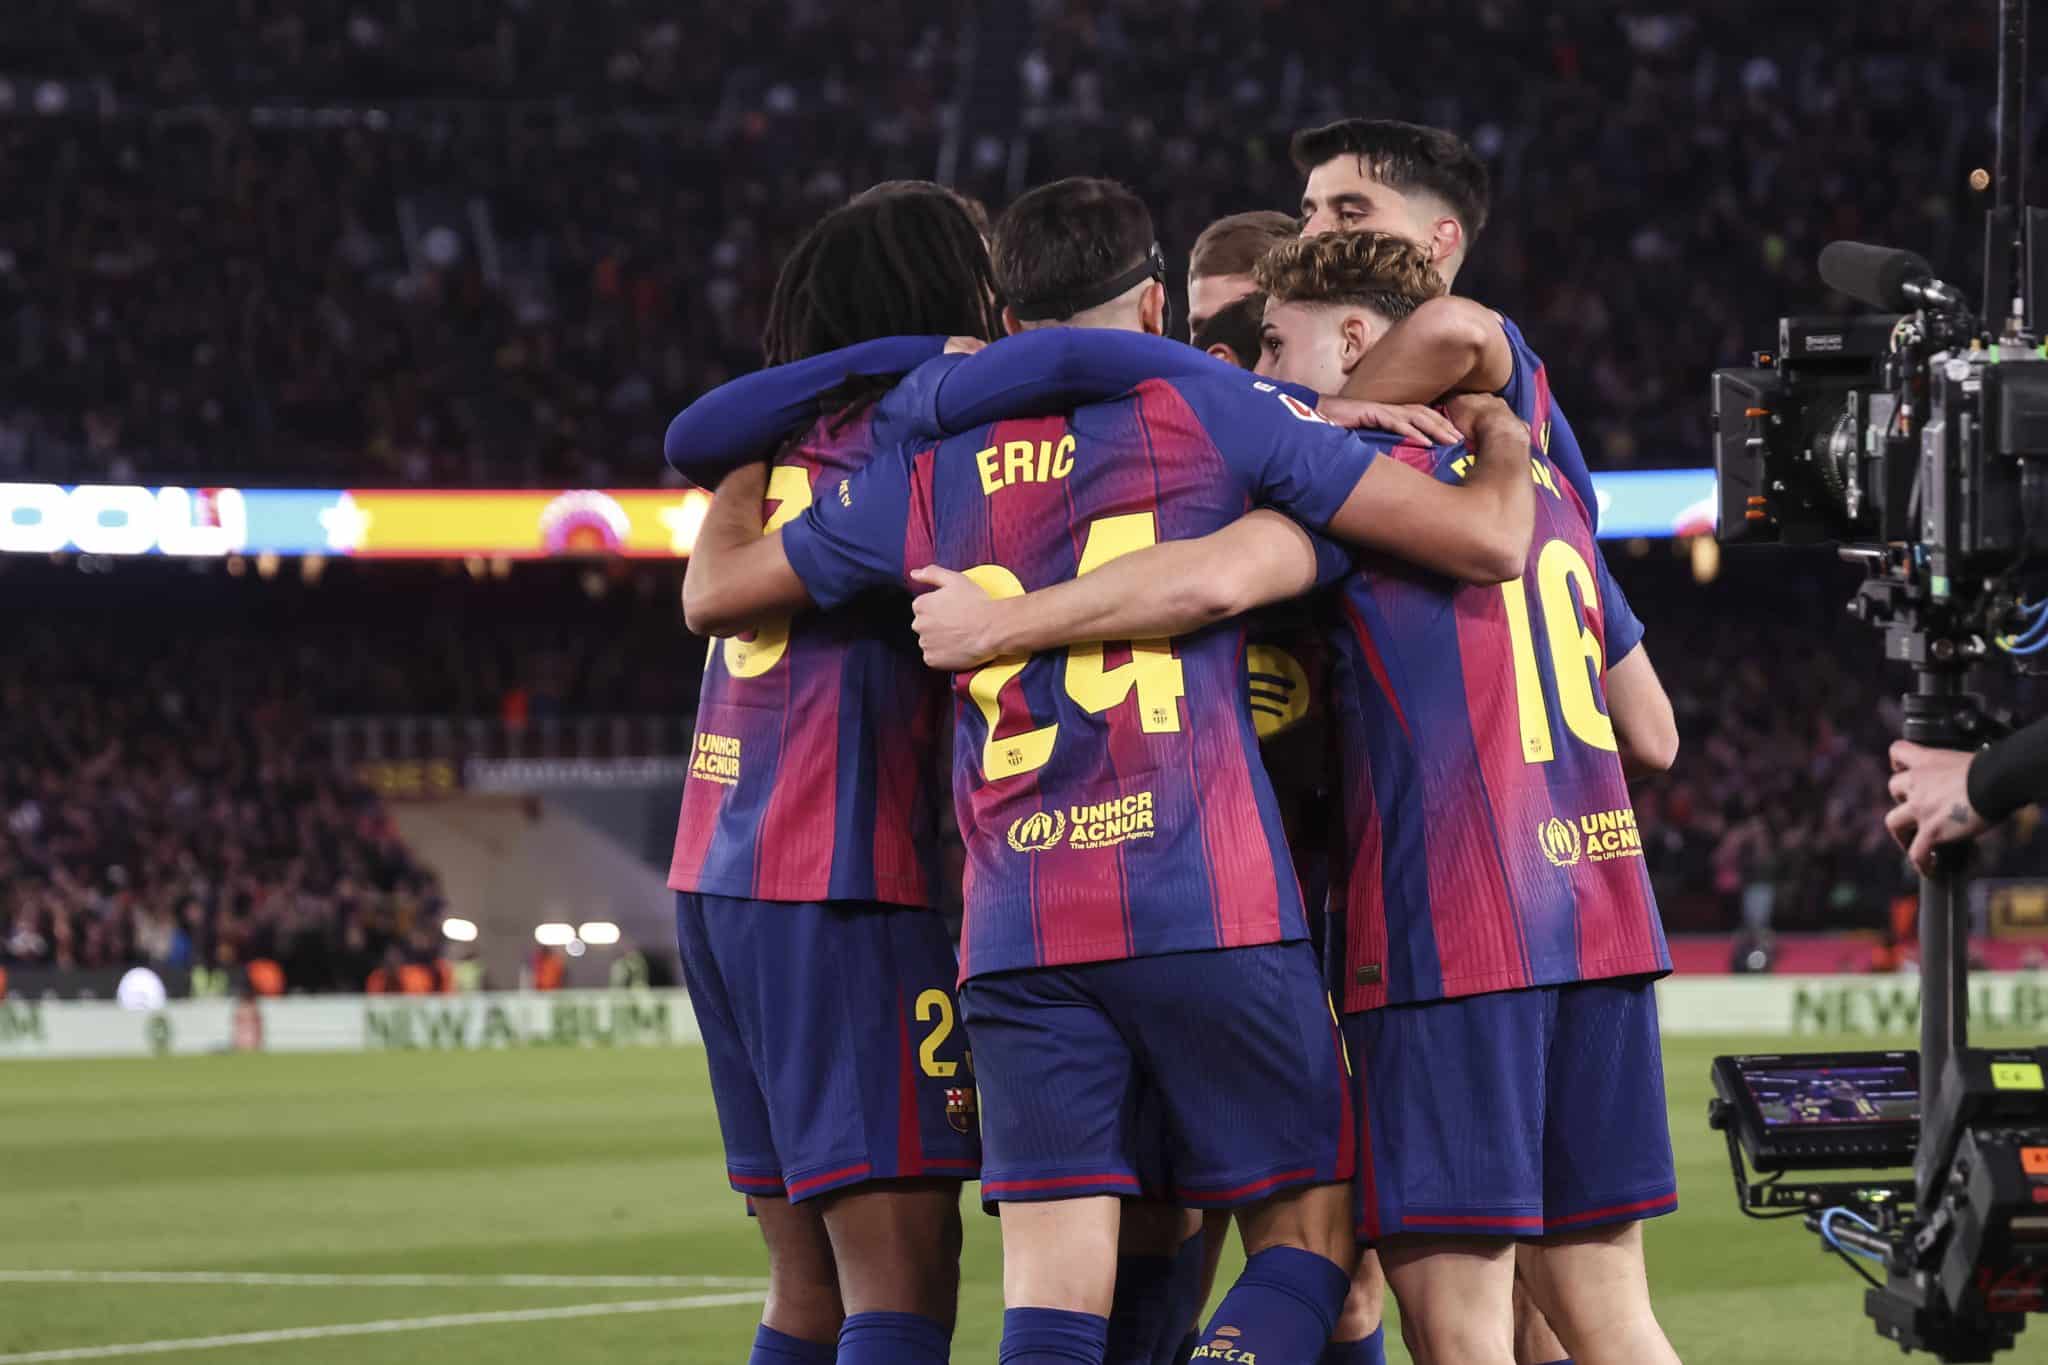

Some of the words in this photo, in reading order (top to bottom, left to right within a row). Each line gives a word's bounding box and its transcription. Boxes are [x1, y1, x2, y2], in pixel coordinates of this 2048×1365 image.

[976, 434, 1076, 496] ERIC
[961, 511, 1185, 782] 24
[1501, 539, 1619, 764] 16
[1069, 810, 1155, 842] ACNUR
[1070, 791, 1153, 825] UNHCR
